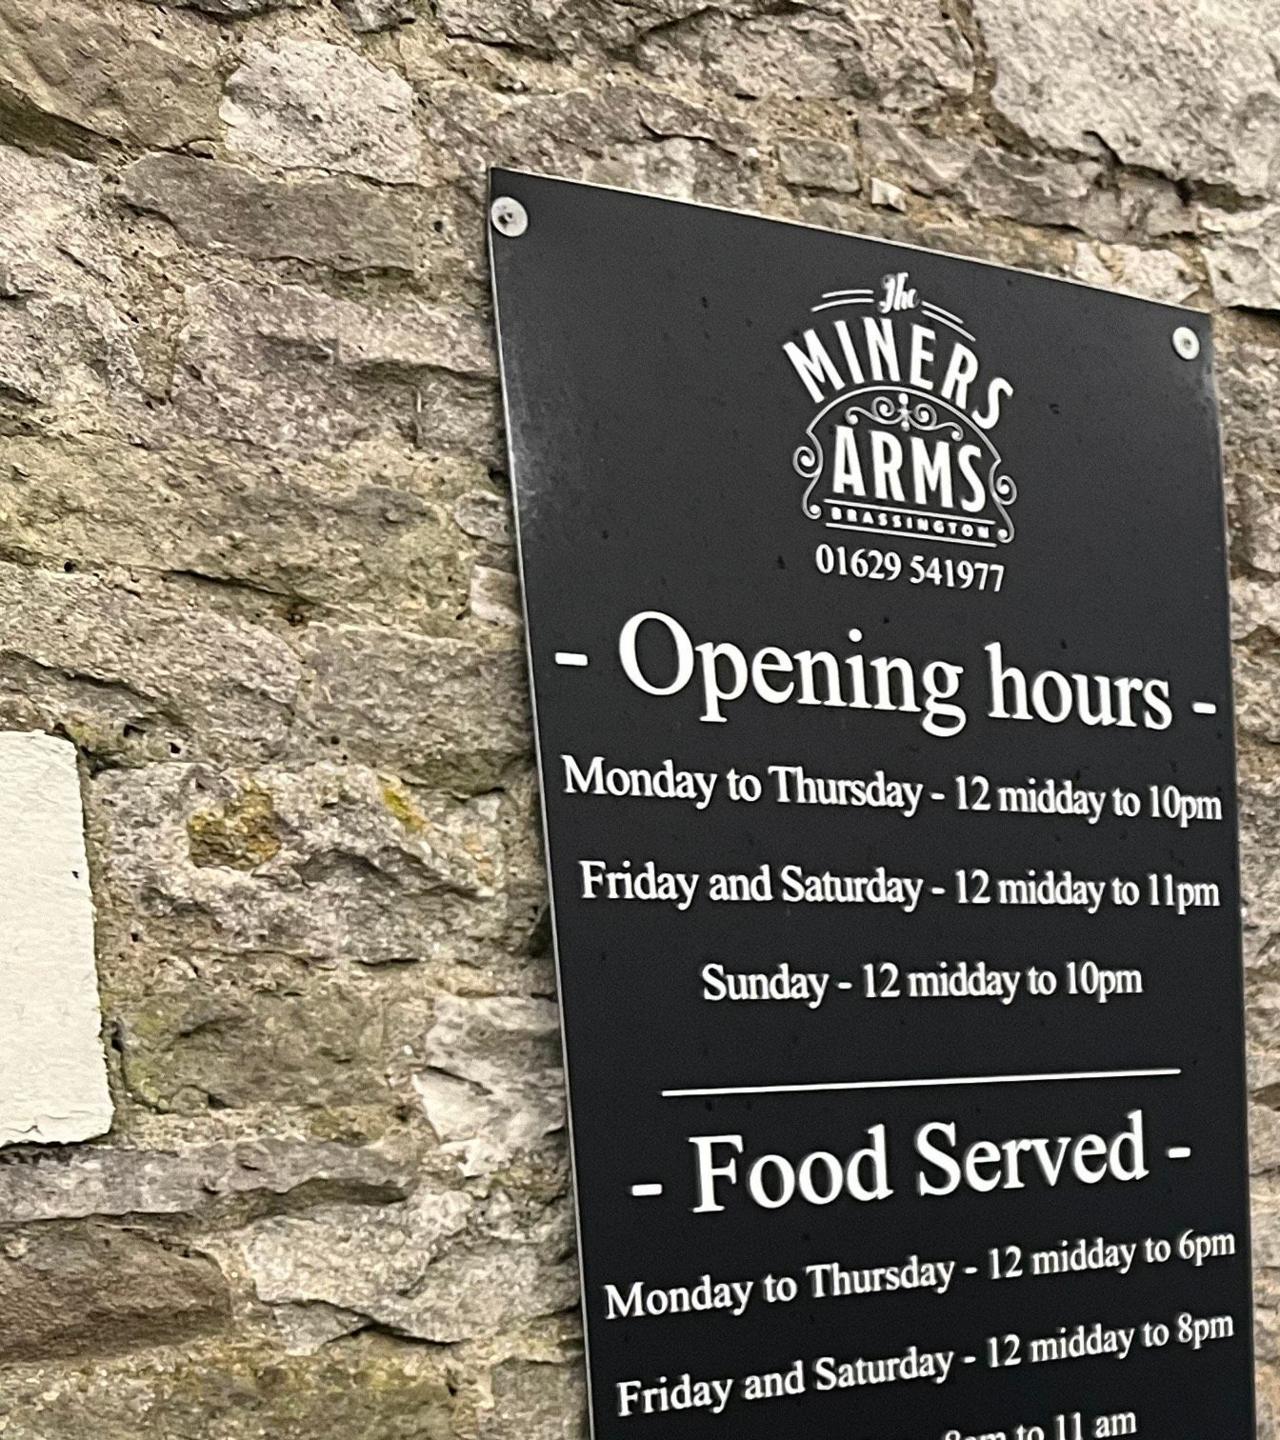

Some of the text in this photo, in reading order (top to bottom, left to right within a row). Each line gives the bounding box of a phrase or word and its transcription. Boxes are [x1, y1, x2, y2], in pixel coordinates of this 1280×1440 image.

[878, 271, 917, 314] The
[783, 317, 1014, 429] MINERS
[832, 425, 986, 512] ARMS
[831, 507, 990, 538] BRASSINGTON
[815, 543, 1005, 592] 01629 541977
[618, 610, 967, 737] Opening
[984, 641, 1173, 730] hours
[560, 754, 718, 810] Monday
[726, 768, 762, 802] to
[767, 765, 924, 818] Thursday
[955, 775, 992, 811] 12
[997, 777, 1107, 825] midday
[1111, 787, 1141, 817] to
[1149, 785, 1223, 829] 10pm
[578, 860, 700, 911] Friday
[709, 863, 774, 902] and
[780, 864, 924, 913] Saturday
[955, 868, 991, 904] 12
[997, 869, 1106, 914] midday
[1111, 877, 1140, 906] to
[1148, 873, 1221, 916] 11pm
[701, 962, 830, 1009] Sunday
[863, 962, 901, 998] 12
[907, 961, 1021, 1005] midday
[1027, 966, 1057, 996] to
[1066, 960, 1143, 1004] 10pm
[688, 1123, 894, 1213] Food
[916, 1109, 1150, 1196] Served
[604, 1274, 754, 1320] Monday
[763, 1274, 798, 1303] to
[805, 1254, 956, 1298] Thursday
[989, 1245, 1023, 1280] 12
[1031, 1236, 1137, 1275] midday
[1144, 1237, 1171, 1263] to
[1178, 1228, 1236, 1267] 6pm
[616, 1373, 734, 1417] Friday
[744, 1359, 806, 1400] and
[815, 1345, 955, 1391] Saturday
[988, 1334, 1022, 1368] 12
[1029, 1322, 1135, 1363] midday
[1142, 1322, 1170, 1348] to
[1177, 1312, 1234, 1350] 8pm
[1095, 1411, 1137, 1439] am
